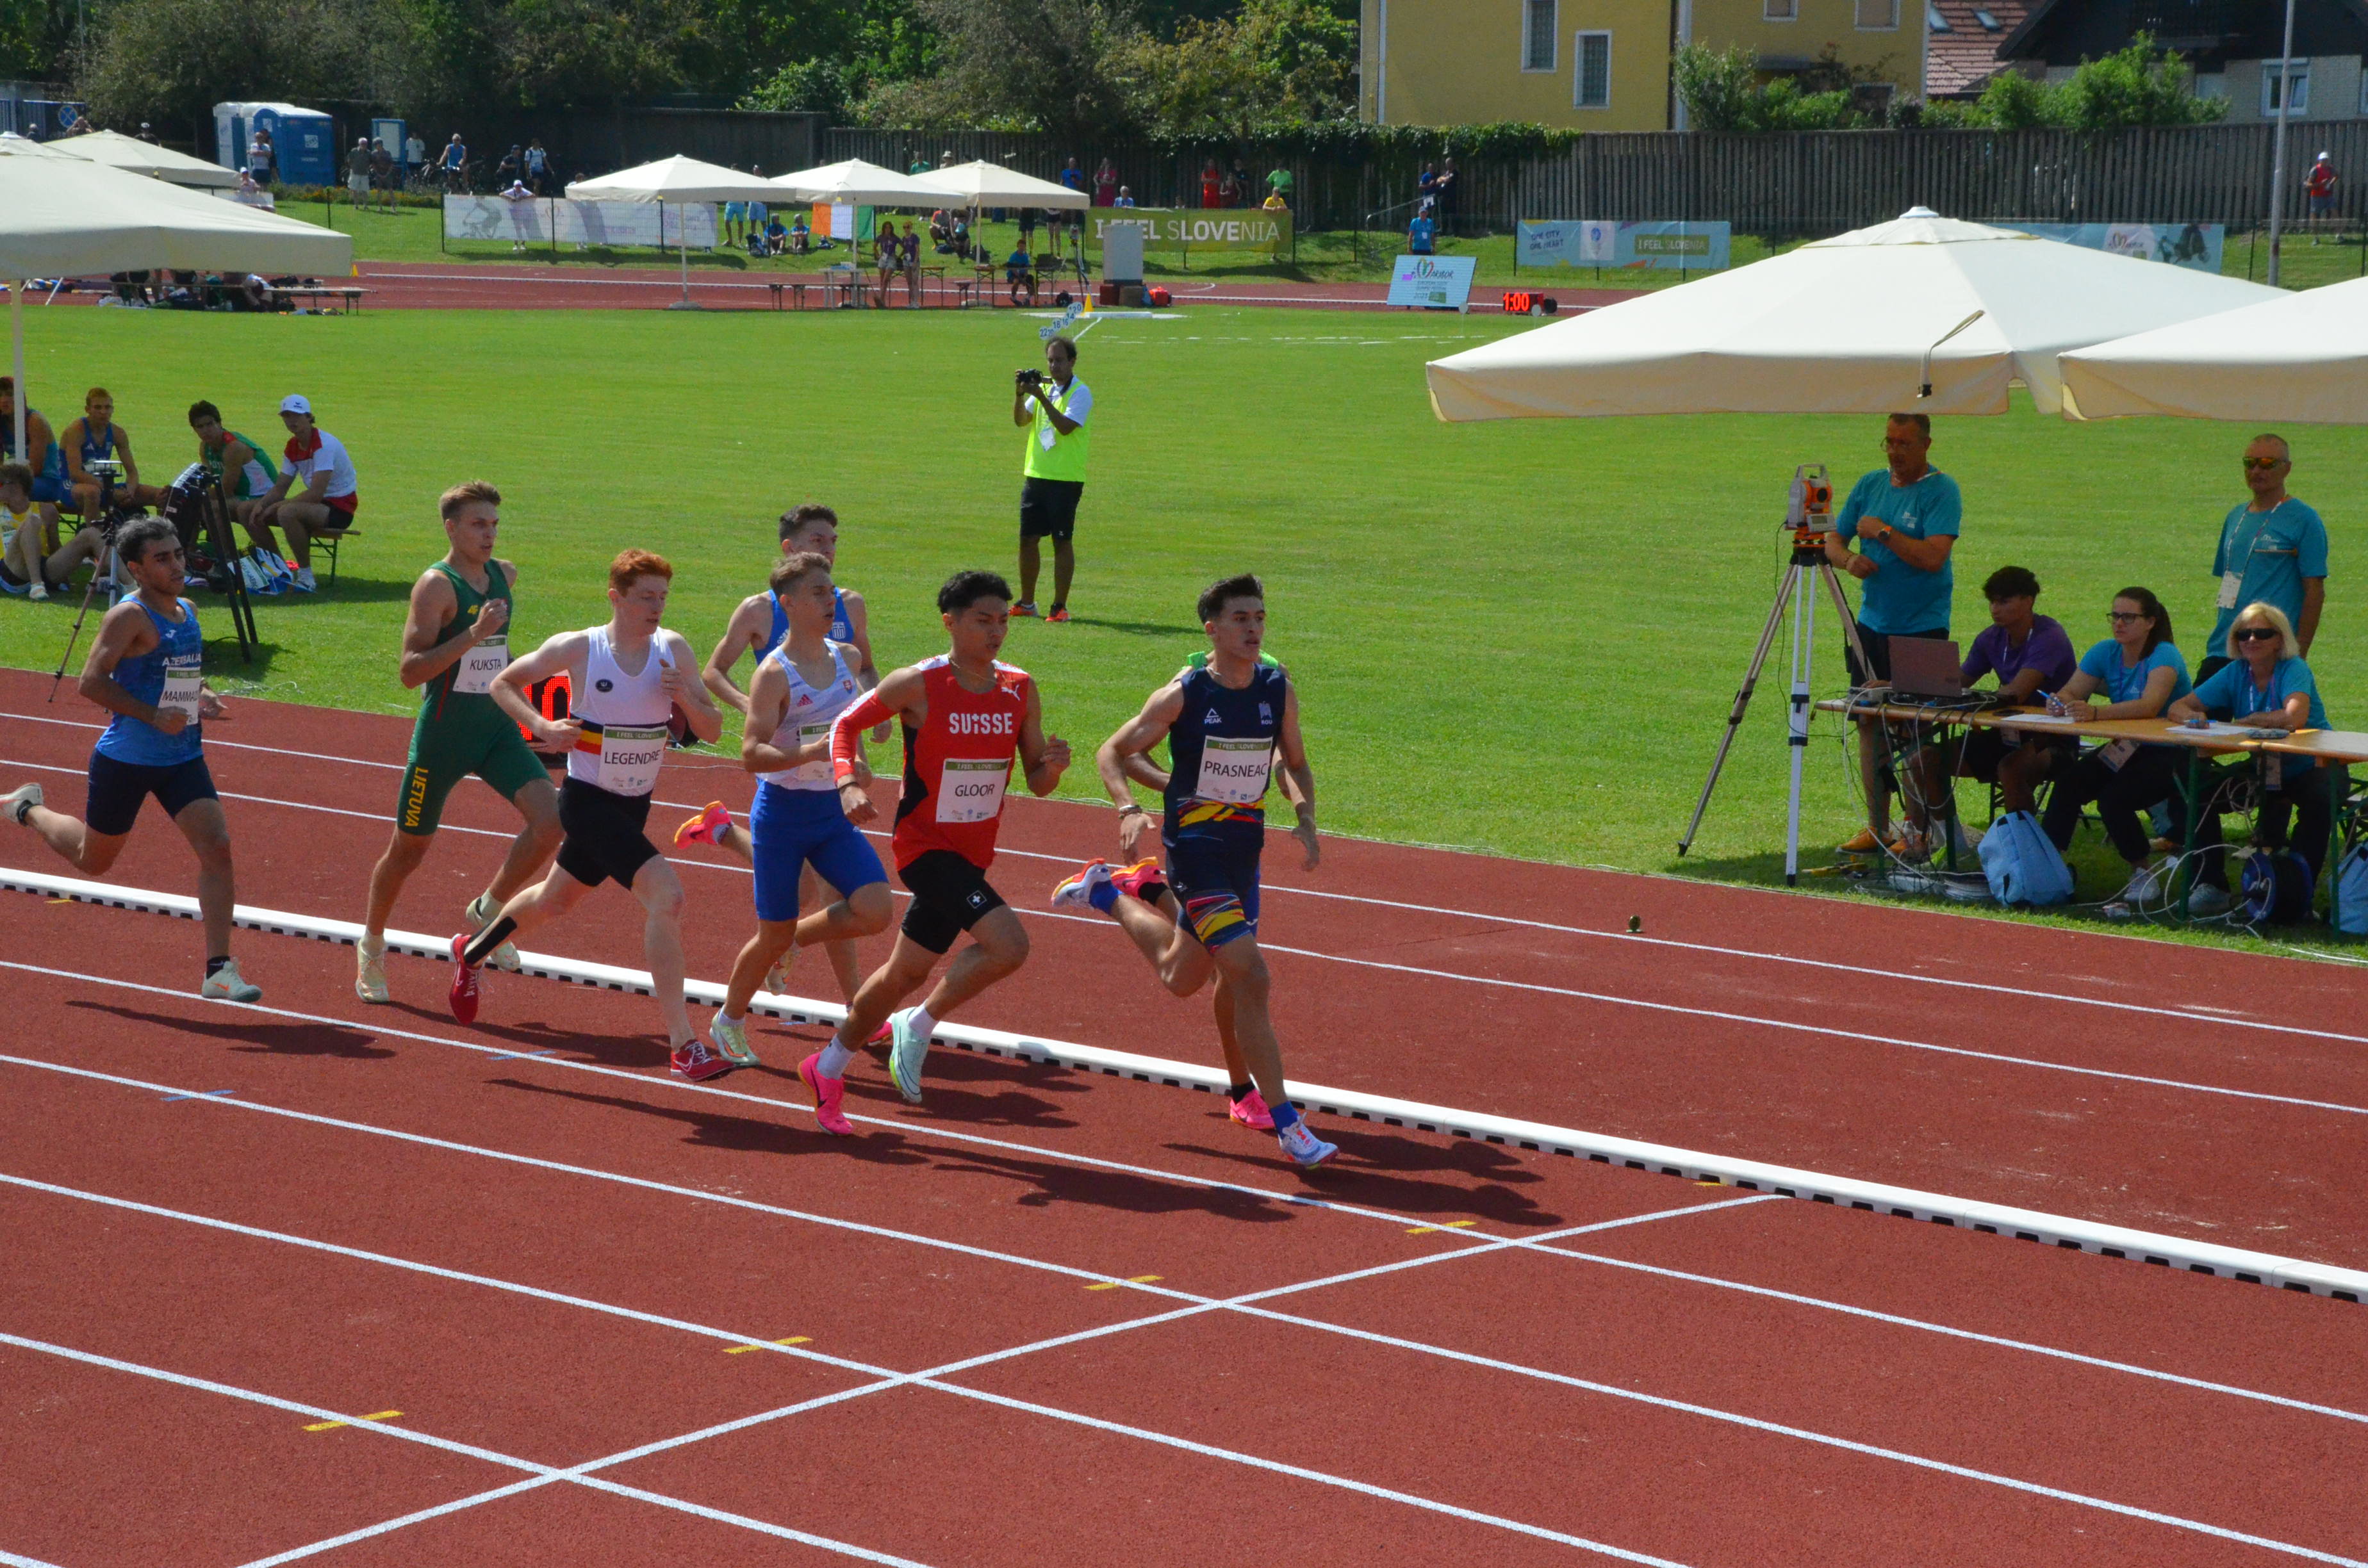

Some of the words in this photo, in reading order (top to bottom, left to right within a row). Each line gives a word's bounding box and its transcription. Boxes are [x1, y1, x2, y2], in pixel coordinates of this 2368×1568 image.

[1095, 219, 1104, 239] I
[1111, 219, 1161, 240] EL
[1167, 220, 1280, 241] SLOVENIA
[1643, 240, 1663, 250] FEEL
[1503, 291, 1529, 311] 1:00
[469, 658, 502, 671] KUKSTA
[604, 749, 661, 765] LEGENDRE
[1204, 760, 1268, 778] PRASNEAC
[404, 767, 429, 827] LIETUVA
[955, 783, 996, 797] GLOOR
